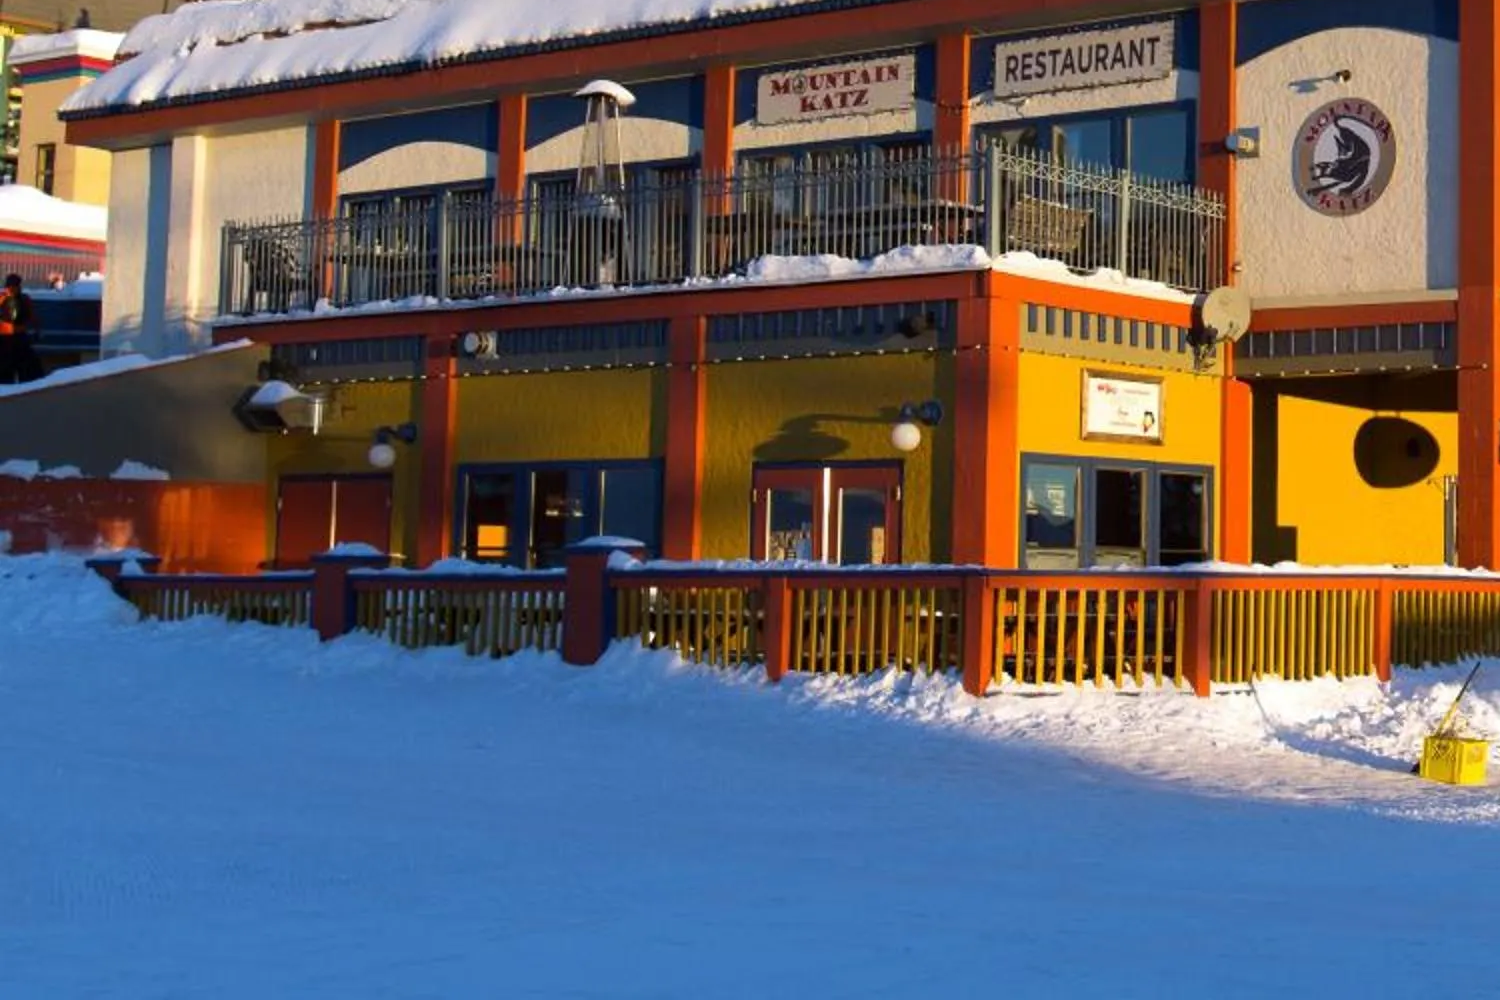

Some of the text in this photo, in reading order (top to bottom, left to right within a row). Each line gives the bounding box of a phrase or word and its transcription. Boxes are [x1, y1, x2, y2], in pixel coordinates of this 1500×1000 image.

[1004, 36, 1161, 83] RESTAURANT
[769, 63, 900, 97] MOUNTAIN
[801, 88, 869, 113] KATZ
